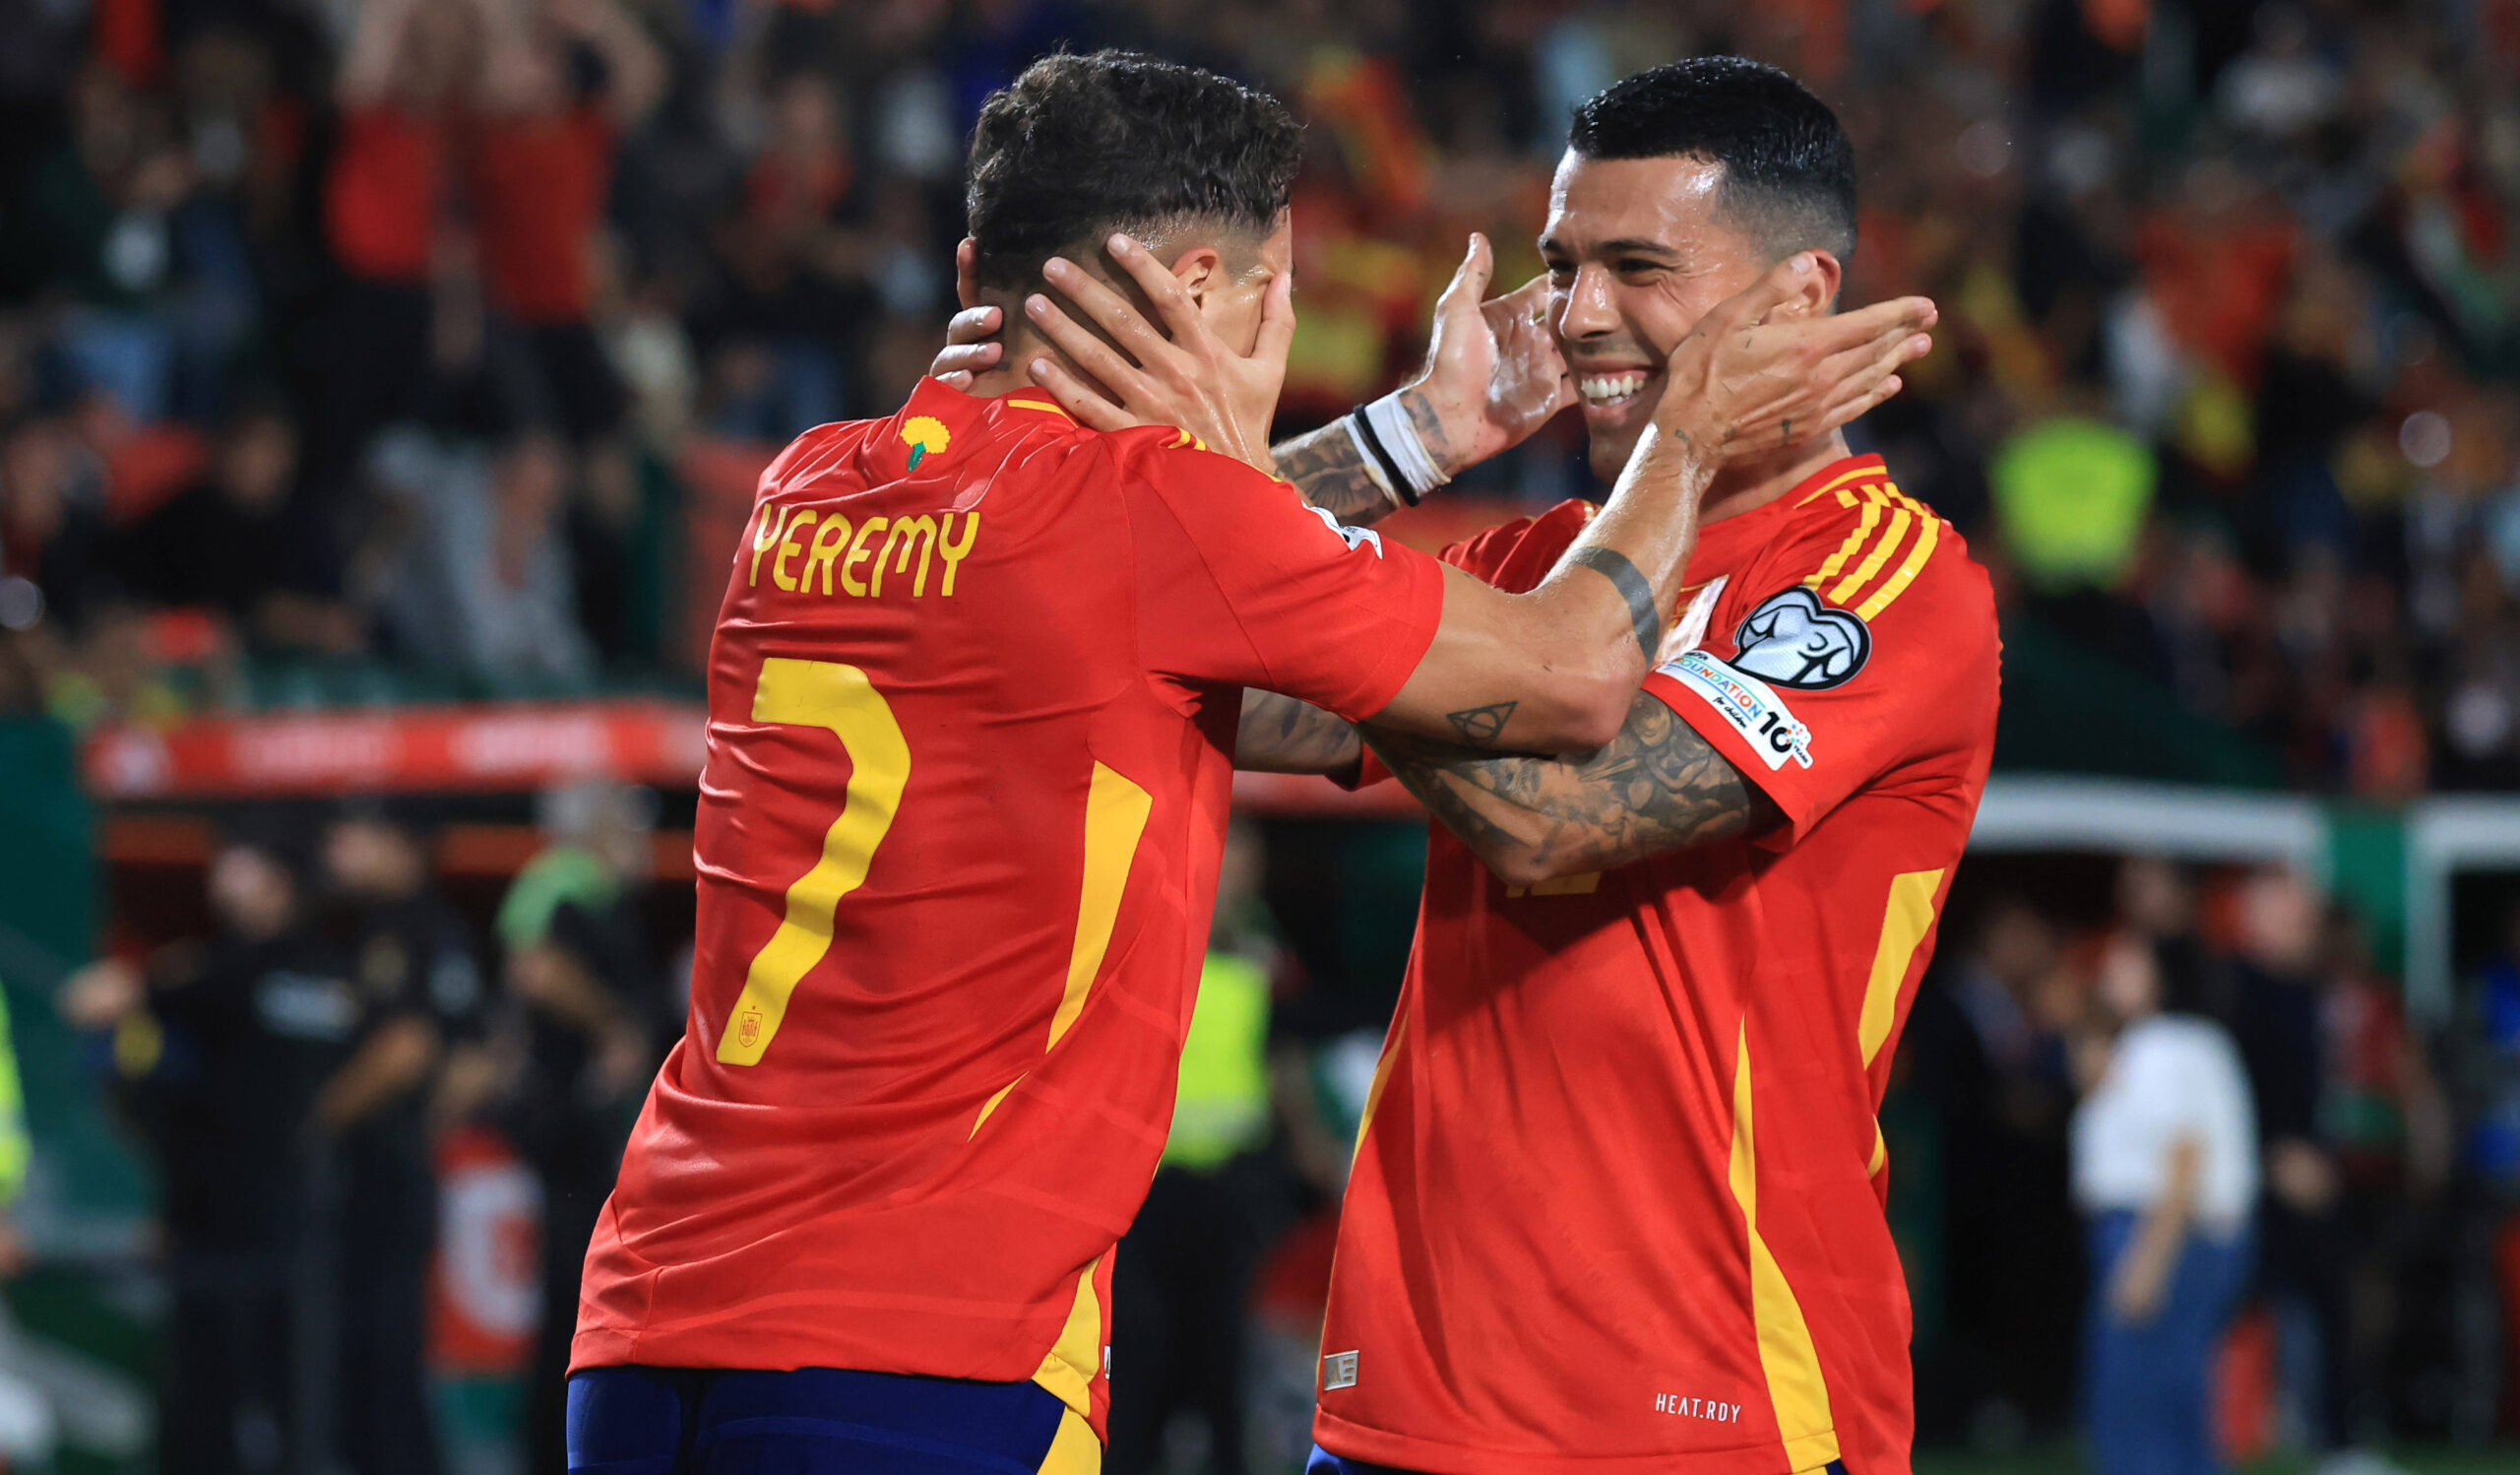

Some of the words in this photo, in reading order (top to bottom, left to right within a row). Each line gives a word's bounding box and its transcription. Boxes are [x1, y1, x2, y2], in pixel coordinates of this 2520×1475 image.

[749, 502, 980, 598] YEREMY
[1759, 711, 1794, 753] 10
[716, 657, 912, 1067] 7
[1655, 1392, 1741, 1424] HEAT.RDY
